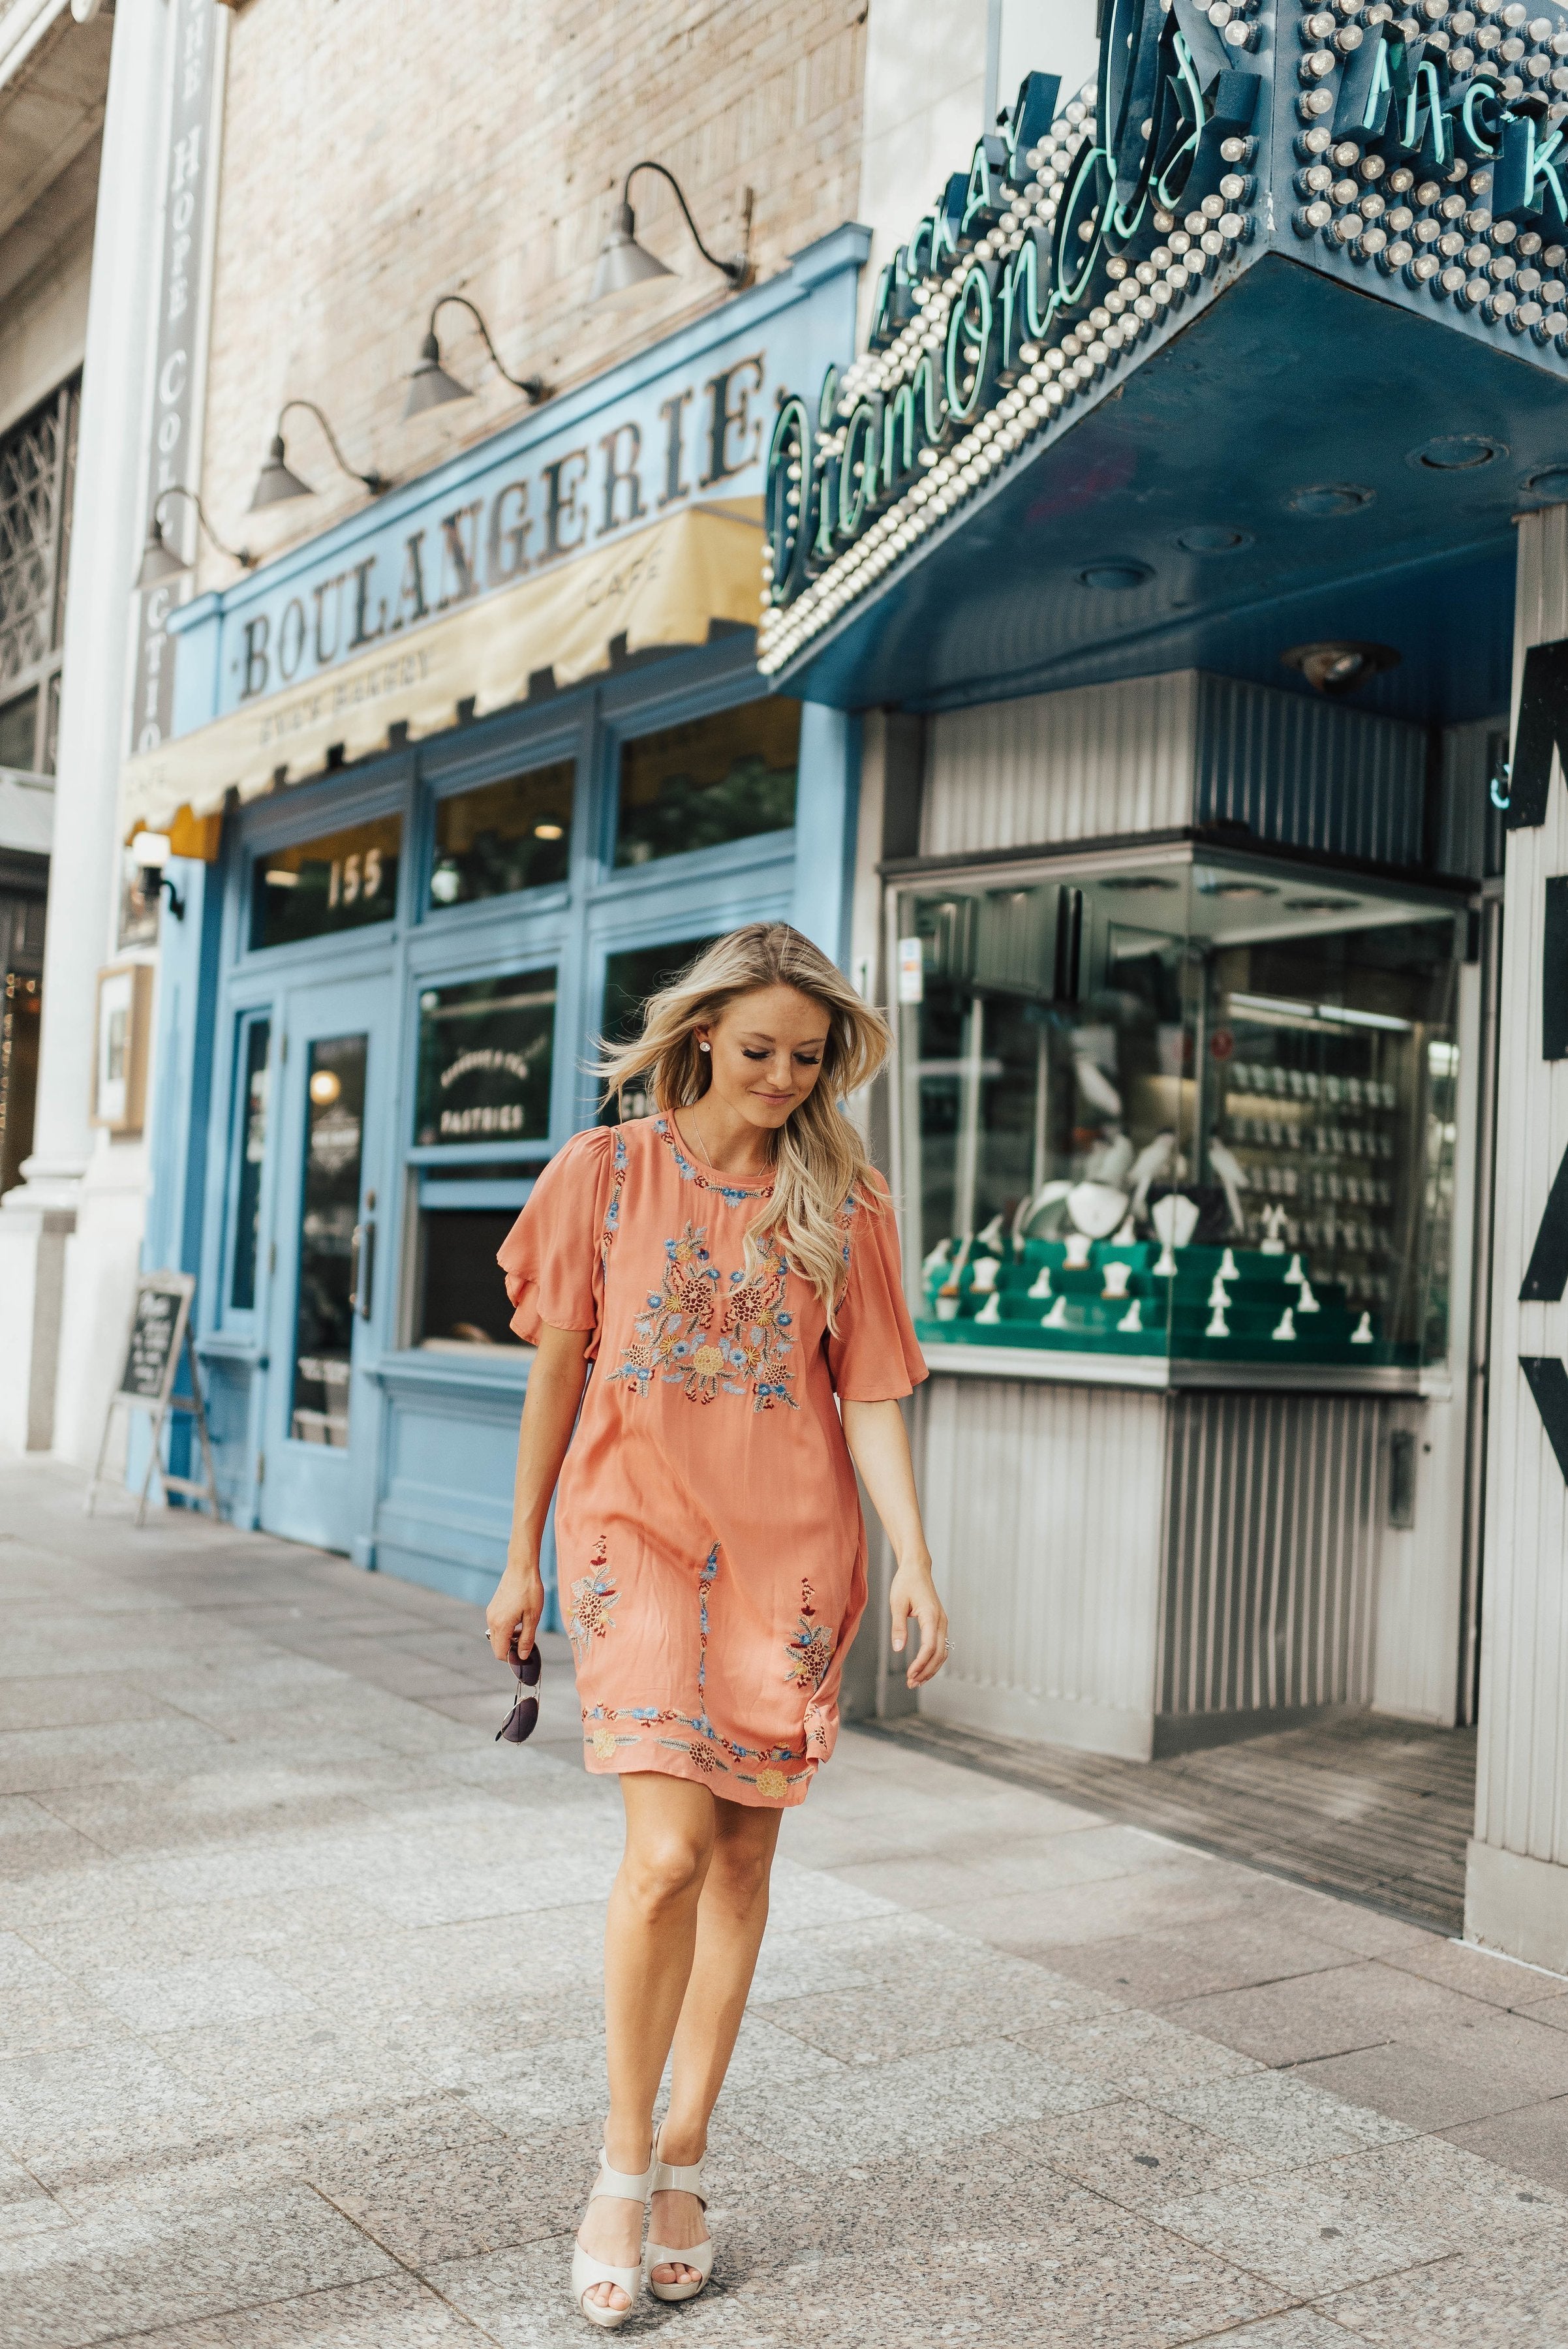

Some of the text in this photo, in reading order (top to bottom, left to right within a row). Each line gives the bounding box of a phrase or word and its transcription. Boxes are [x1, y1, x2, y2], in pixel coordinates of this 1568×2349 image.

[183, 0, 206, 100] HE
[172, 125, 201, 320] HOPE
[765, 0, 1259, 604] Diamonds
[238, 352, 766, 701] BOULANGERIE
[328, 848, 381, 909] 155
[440, 1105, 525, 1134] PASTRIES
